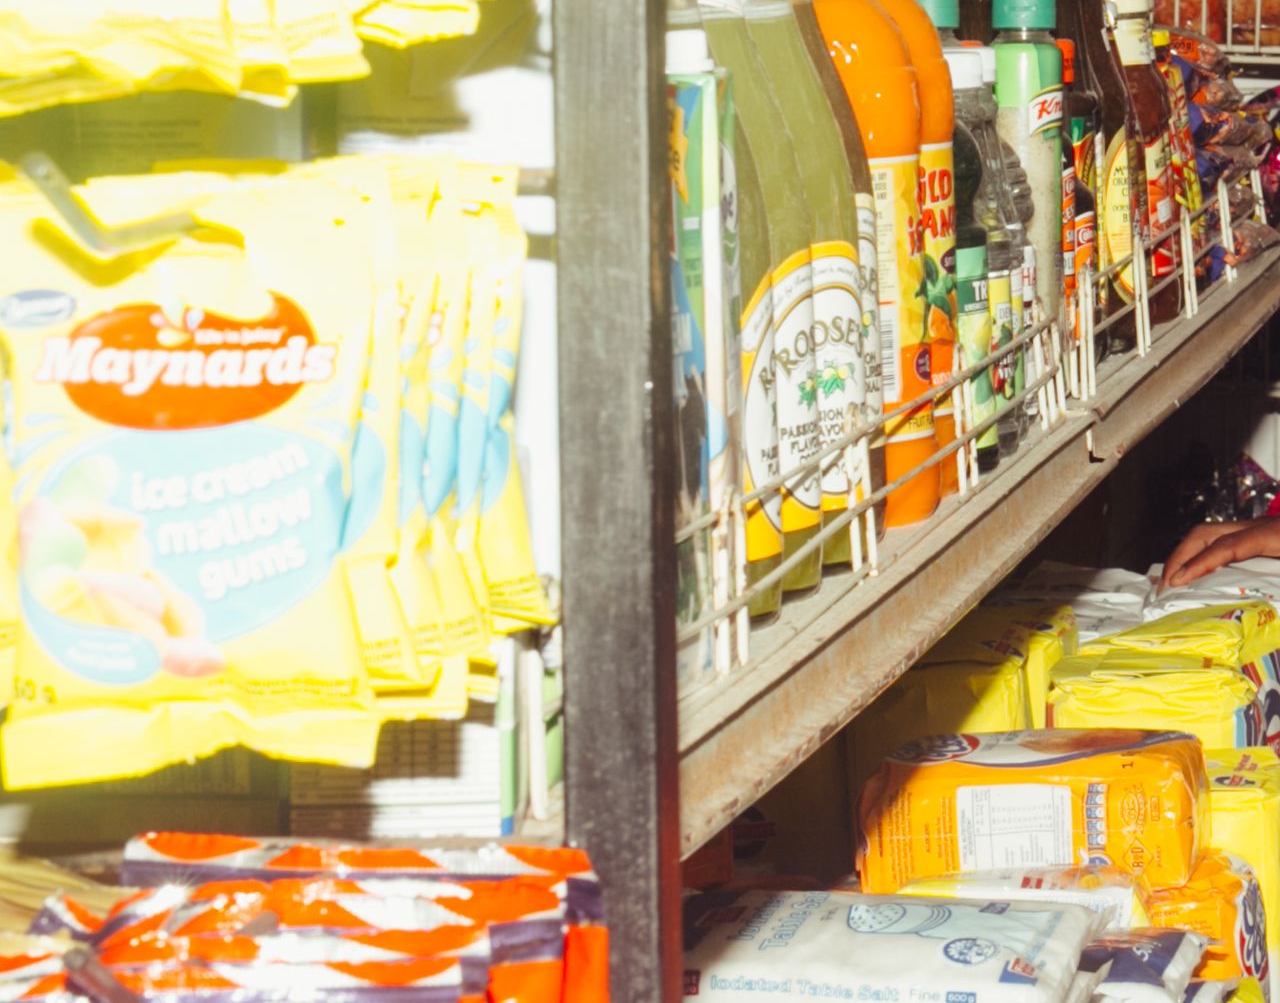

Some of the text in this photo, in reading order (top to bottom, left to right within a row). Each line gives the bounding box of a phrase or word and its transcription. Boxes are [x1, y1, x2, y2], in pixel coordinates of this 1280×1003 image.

[33, 337, 338, 395] Maynards
[130, 442, 311, 512] ice cream
[157, 486, 313, 556] mallow
[199, 534, 307, 603] gums
[710, 974, 791, 992] Iodated
[796, 979, 854, 1000] Table
[857, 984, 900, 1003] Salt
[909, 987, 941, 1002] Fine
